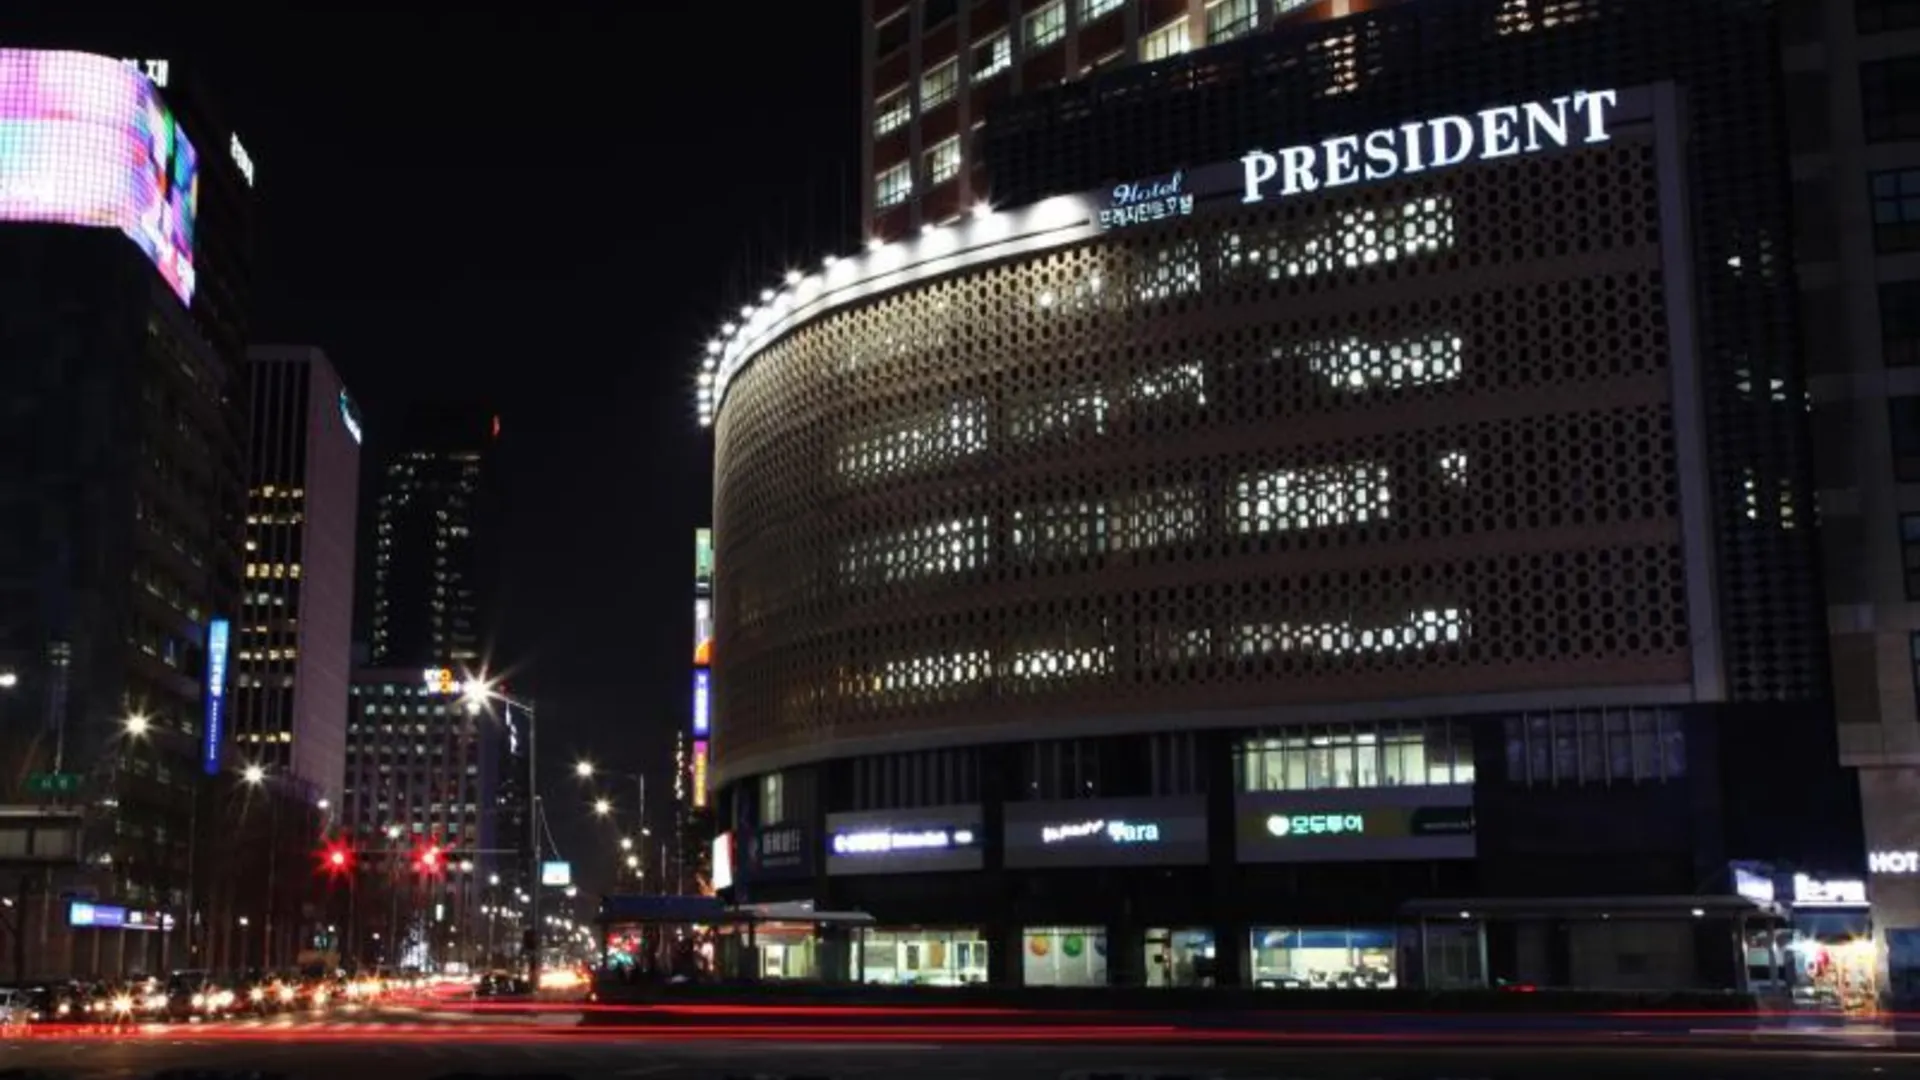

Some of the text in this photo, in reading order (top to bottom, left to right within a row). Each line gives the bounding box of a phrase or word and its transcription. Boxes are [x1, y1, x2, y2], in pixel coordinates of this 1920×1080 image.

[1241, 89, 1617, 204] PRESIDENT
[1112, 171, 1182, 204] Hotel
[1291, 814, 1365, 835] 모두투어
[1868, 851, 1919, 873] HOT
